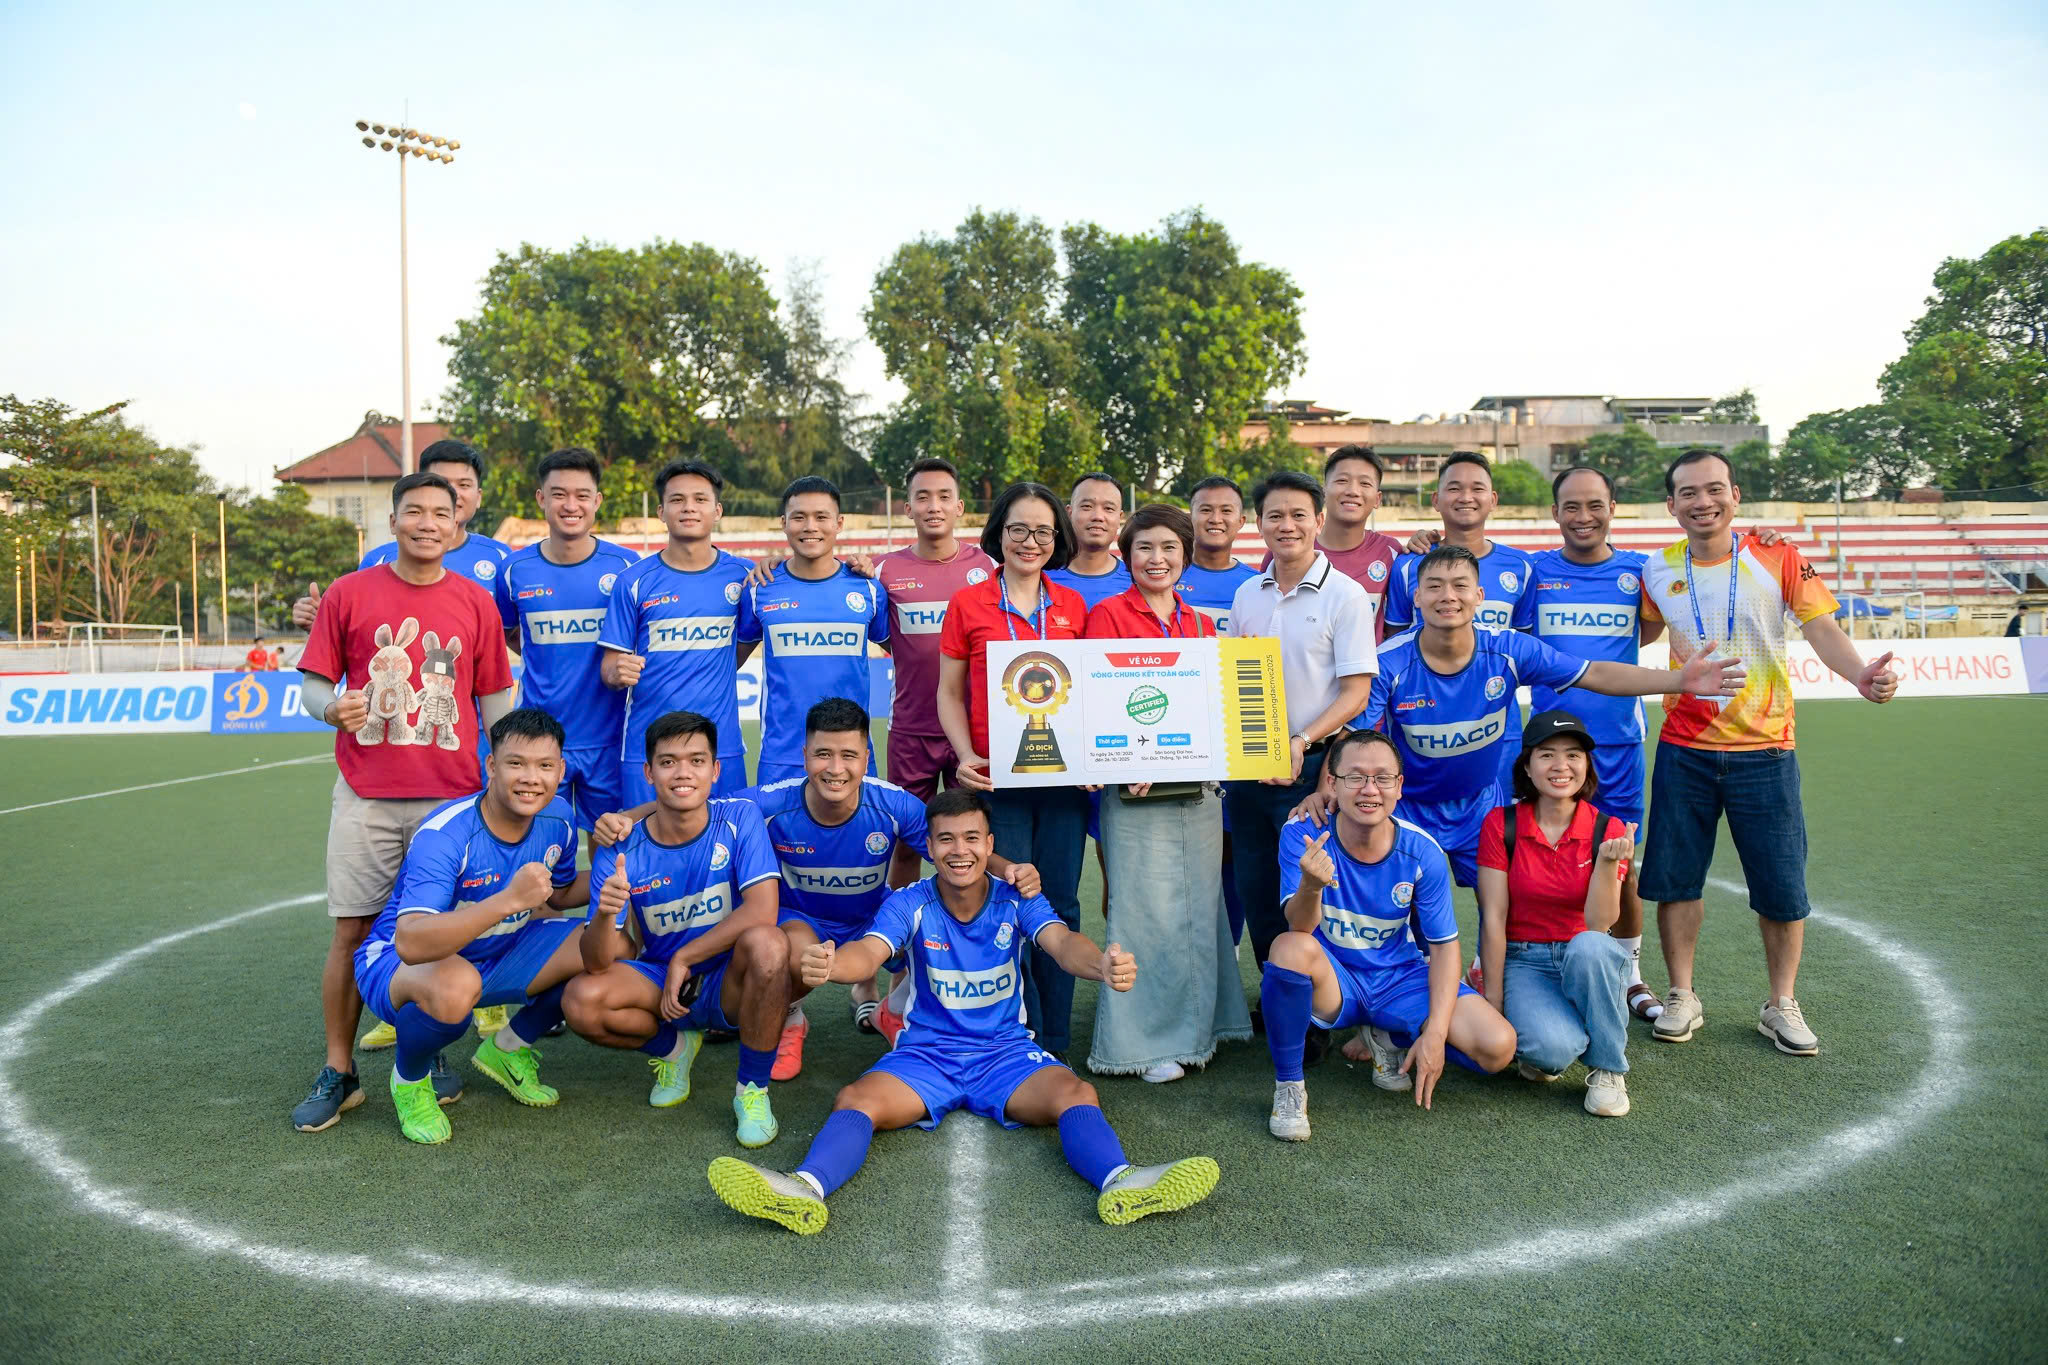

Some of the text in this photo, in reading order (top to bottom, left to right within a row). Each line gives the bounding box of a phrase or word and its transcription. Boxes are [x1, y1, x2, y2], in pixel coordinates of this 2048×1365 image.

[1545, 612, 1629, 628] THACO
[657, 625, 731, 641] THACO
[777, 631, 859, 647] THACO
[1914, 654, 2012, 681] KHANG
[6, 686, 209, 724] SAWACO
[1129, 697, 1165, 713] CERTIFIED
[1411, 720, 1499, 749] THACO
[1274, 738, 1282, 762] CODE
[791, 871, 879, 888] THACO
[932, 973, 1012, 999] THACO
